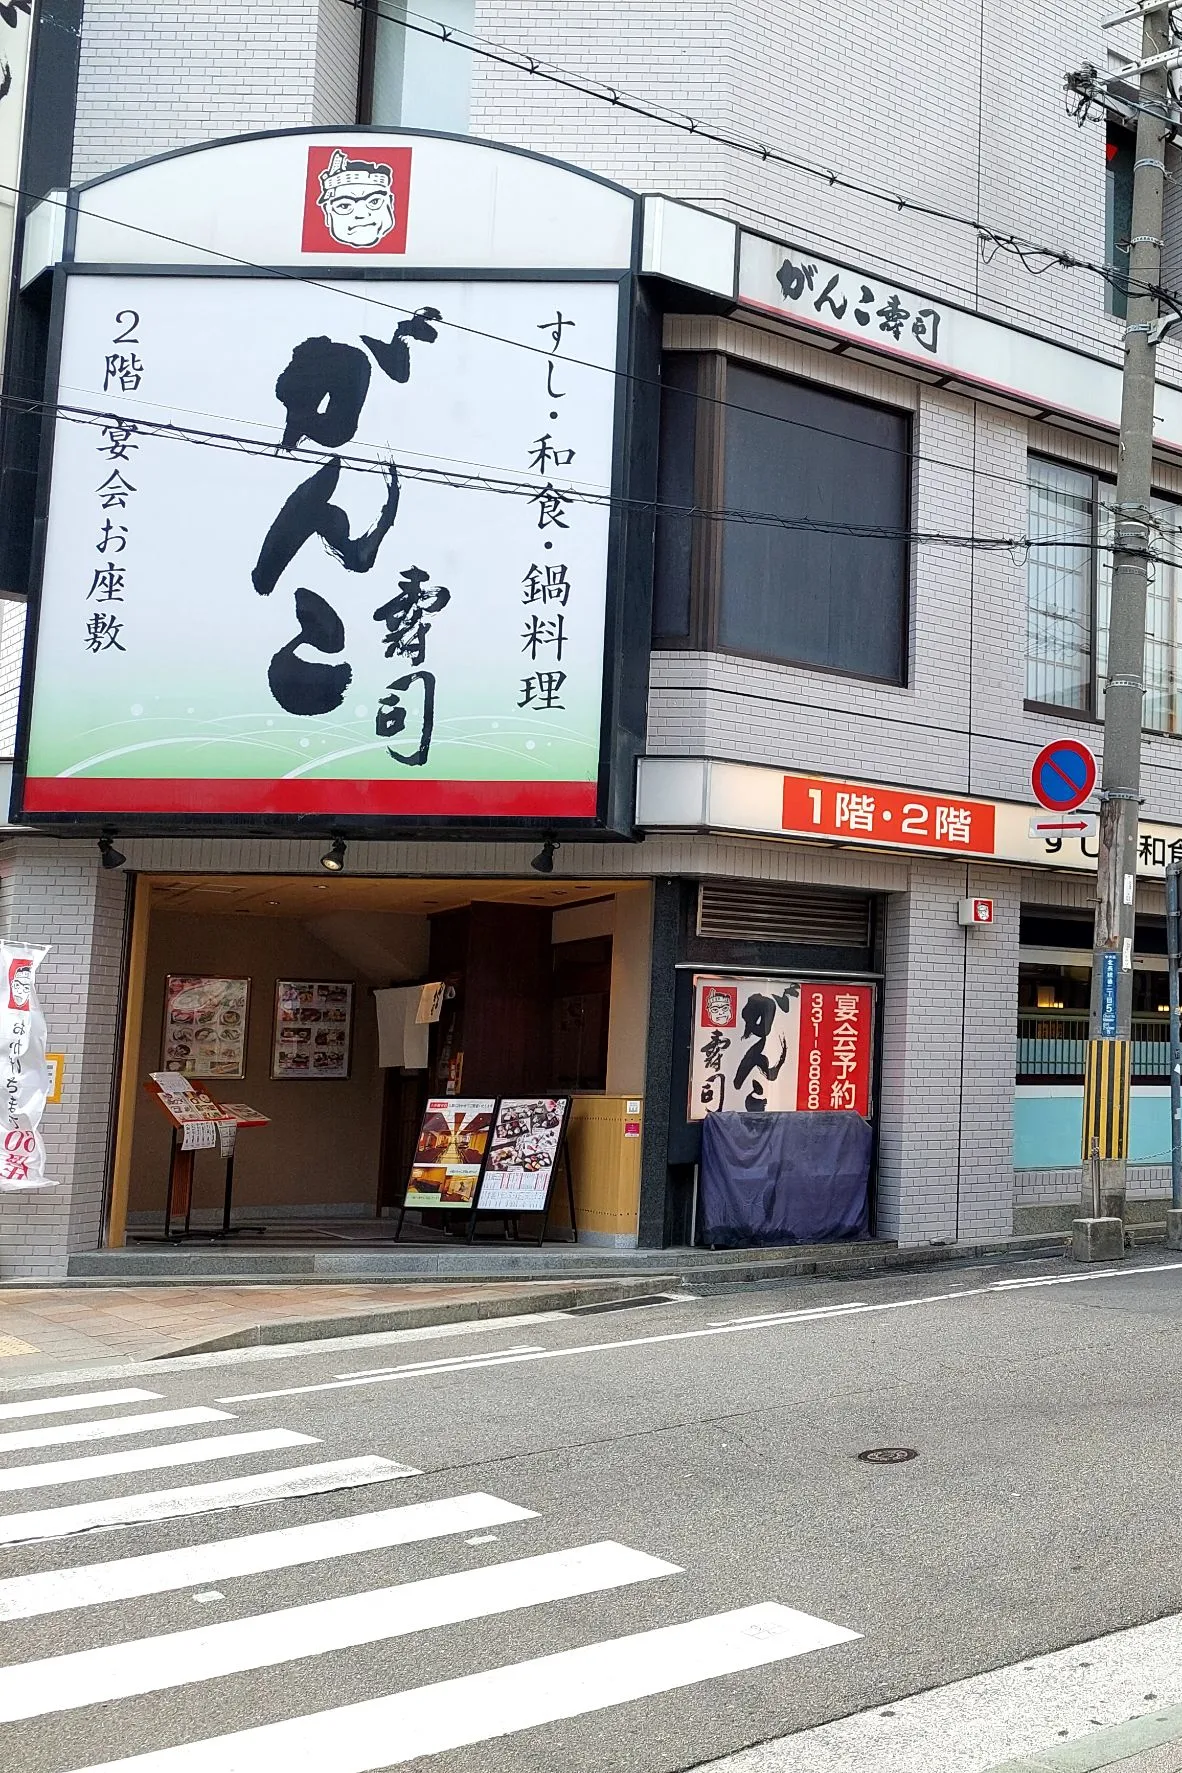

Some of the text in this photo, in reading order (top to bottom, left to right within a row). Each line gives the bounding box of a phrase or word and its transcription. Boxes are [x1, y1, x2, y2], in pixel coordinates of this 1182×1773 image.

[83, 307, 146, 655] 2階 宴会お座敷
[251, 305, 444, 718] がんこ
[516, 309, 577, 713] すし・和食・鍋料理
[806, 786, 973, 845] 1階・2階
[733, 982, 800, 1112] がんこ
[807, 992, 824, 1110] 331-6868
[829, 992, 860, 1110] 宴会予約
